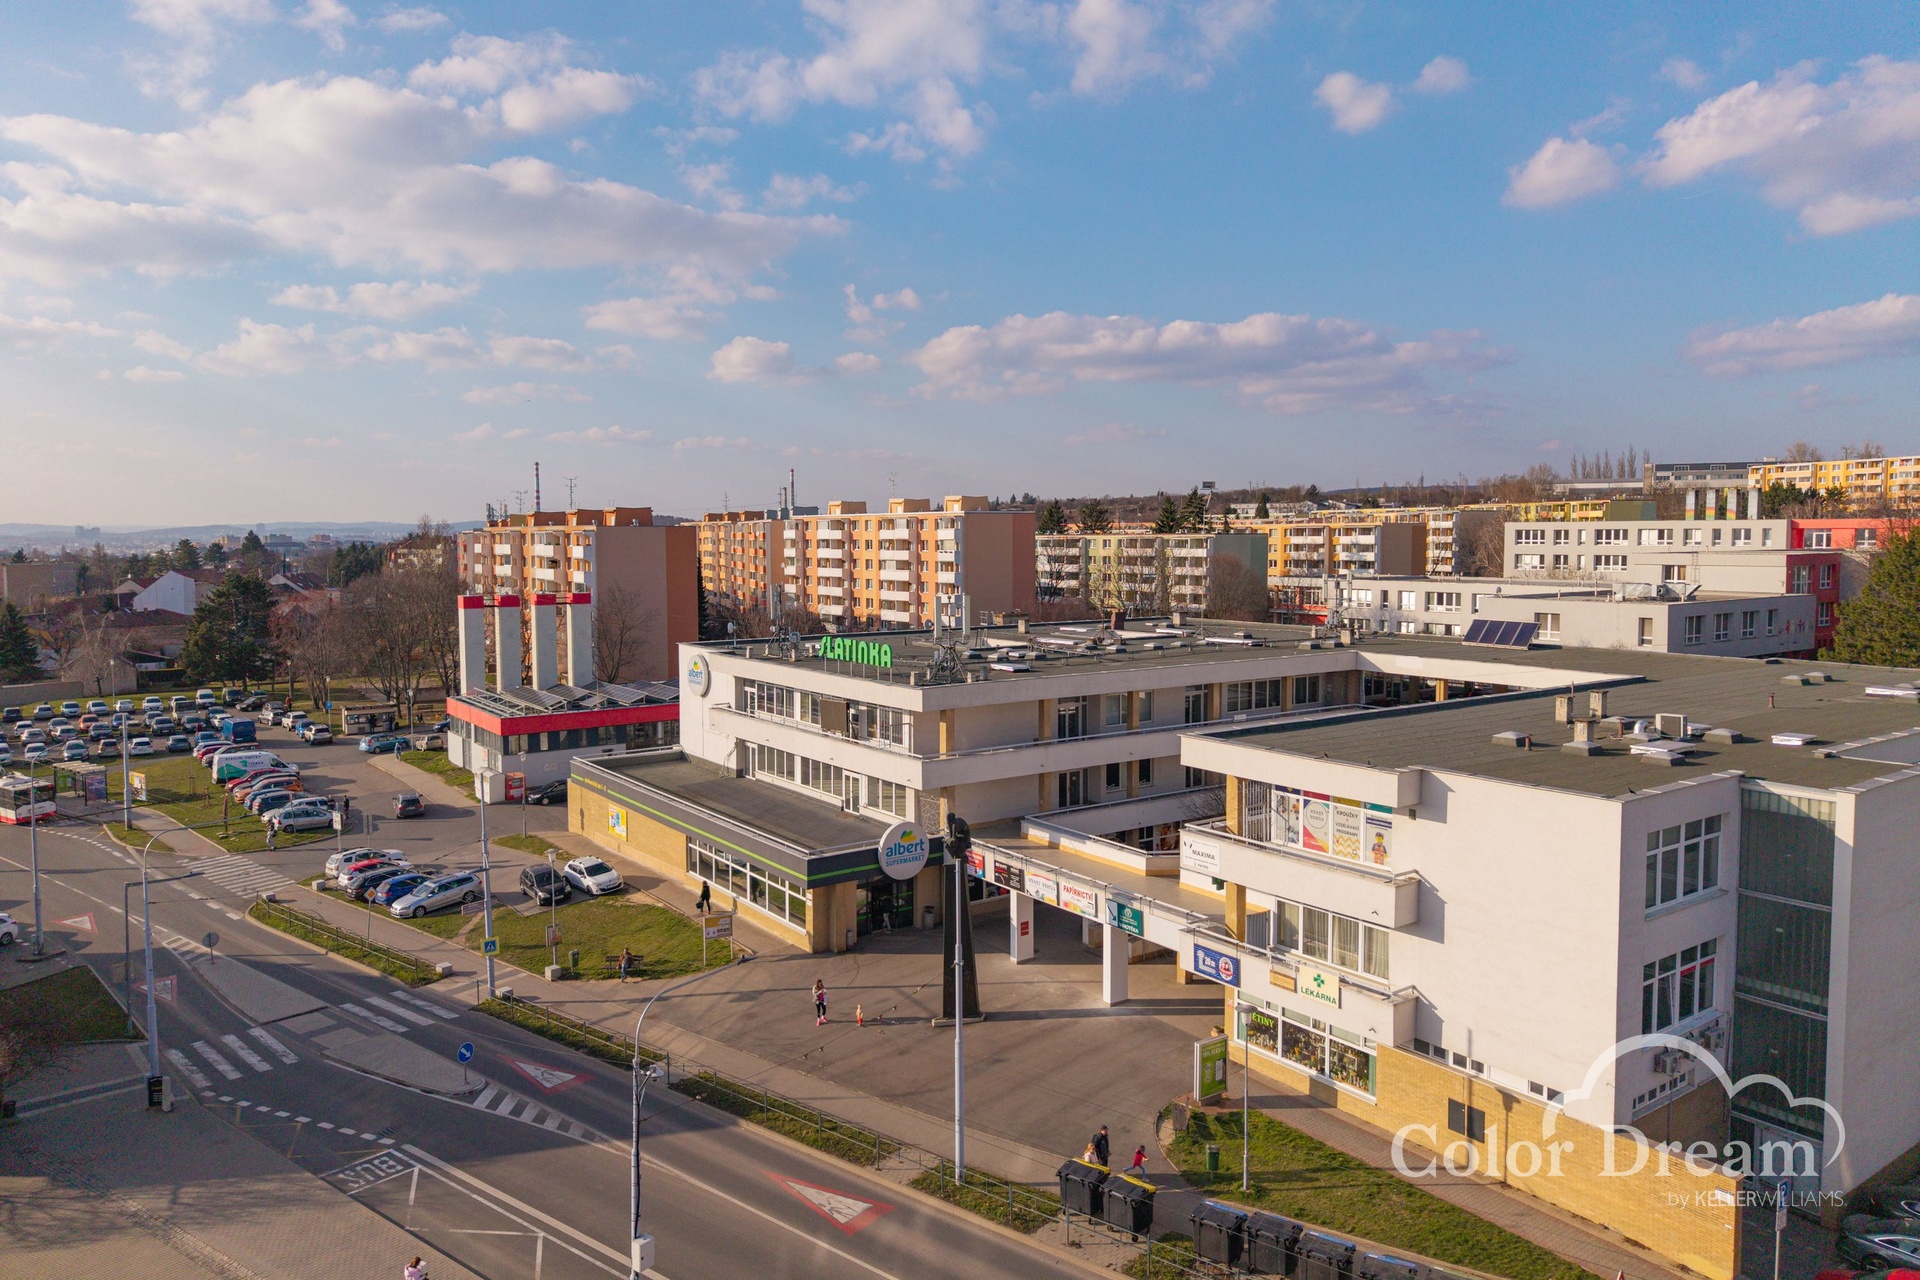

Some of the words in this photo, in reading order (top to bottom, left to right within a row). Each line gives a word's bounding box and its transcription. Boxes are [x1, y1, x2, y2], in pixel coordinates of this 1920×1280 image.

[818, 636, 892, 668] SLATINKA
[688, 668, 703, 679] albert
[1336, 809, 1358, 819] KROUŽKY
[886, 838, 925, 857] albert
[1192, 849, 1215, 860] MAXIMA
[886, 855, 924, 867] SUPERMARKET
[1063, 884, 1093, 902] PAPÍRNICTVÍ
[1300, 986, 1337, 1005] LÉKÁRNA
[1252, 1012, 1274, 1028] ĚTINY
[337, 1156, 404, 1188] BUS
